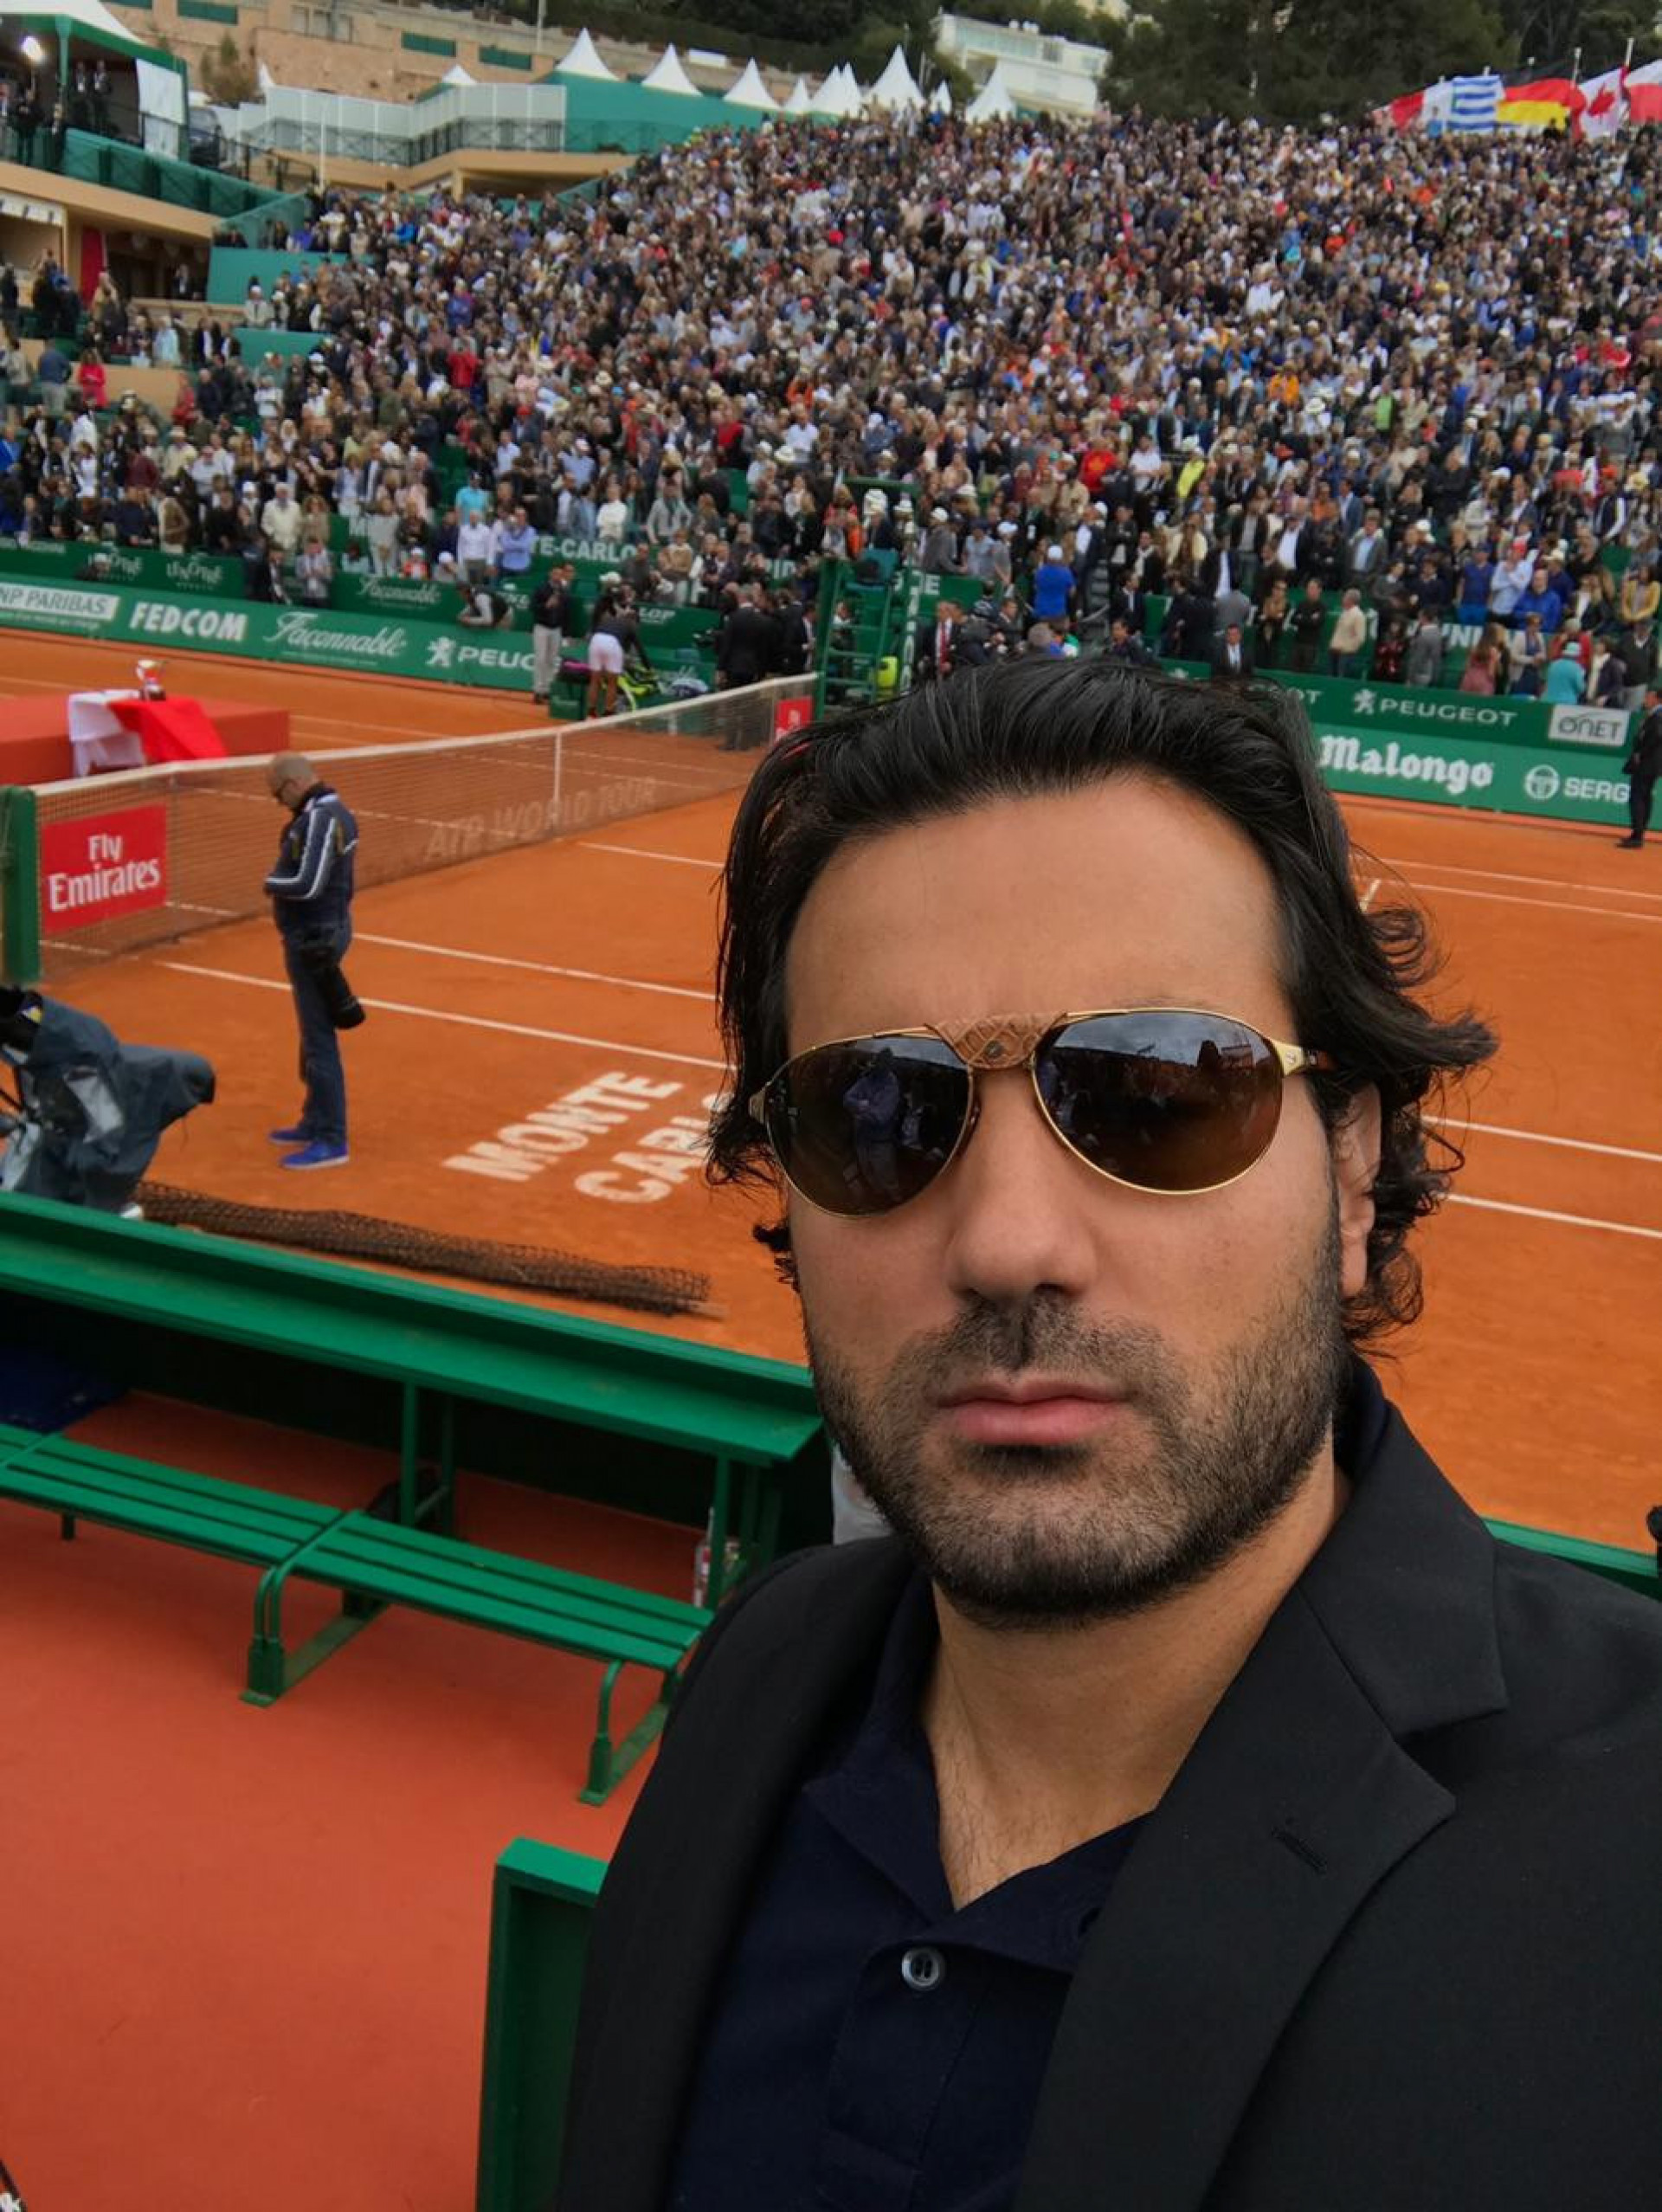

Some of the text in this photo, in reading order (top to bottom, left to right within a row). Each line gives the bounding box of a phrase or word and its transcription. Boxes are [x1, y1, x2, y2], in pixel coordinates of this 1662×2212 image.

[0, 586, 108, 614] NP PARIBAS
[130, 602, 248, 642] FEDCOM
[1380, 699, 1517, 726] PEUGEOT
[1317, 734, 1493, 795] Malongo
[1564, 777, 1631, 803] SERG
[88, 833, 123, 862] Fly
[48, 858, 161, 913] Emirates
[442, 1072, 684, 1181] MONTE
